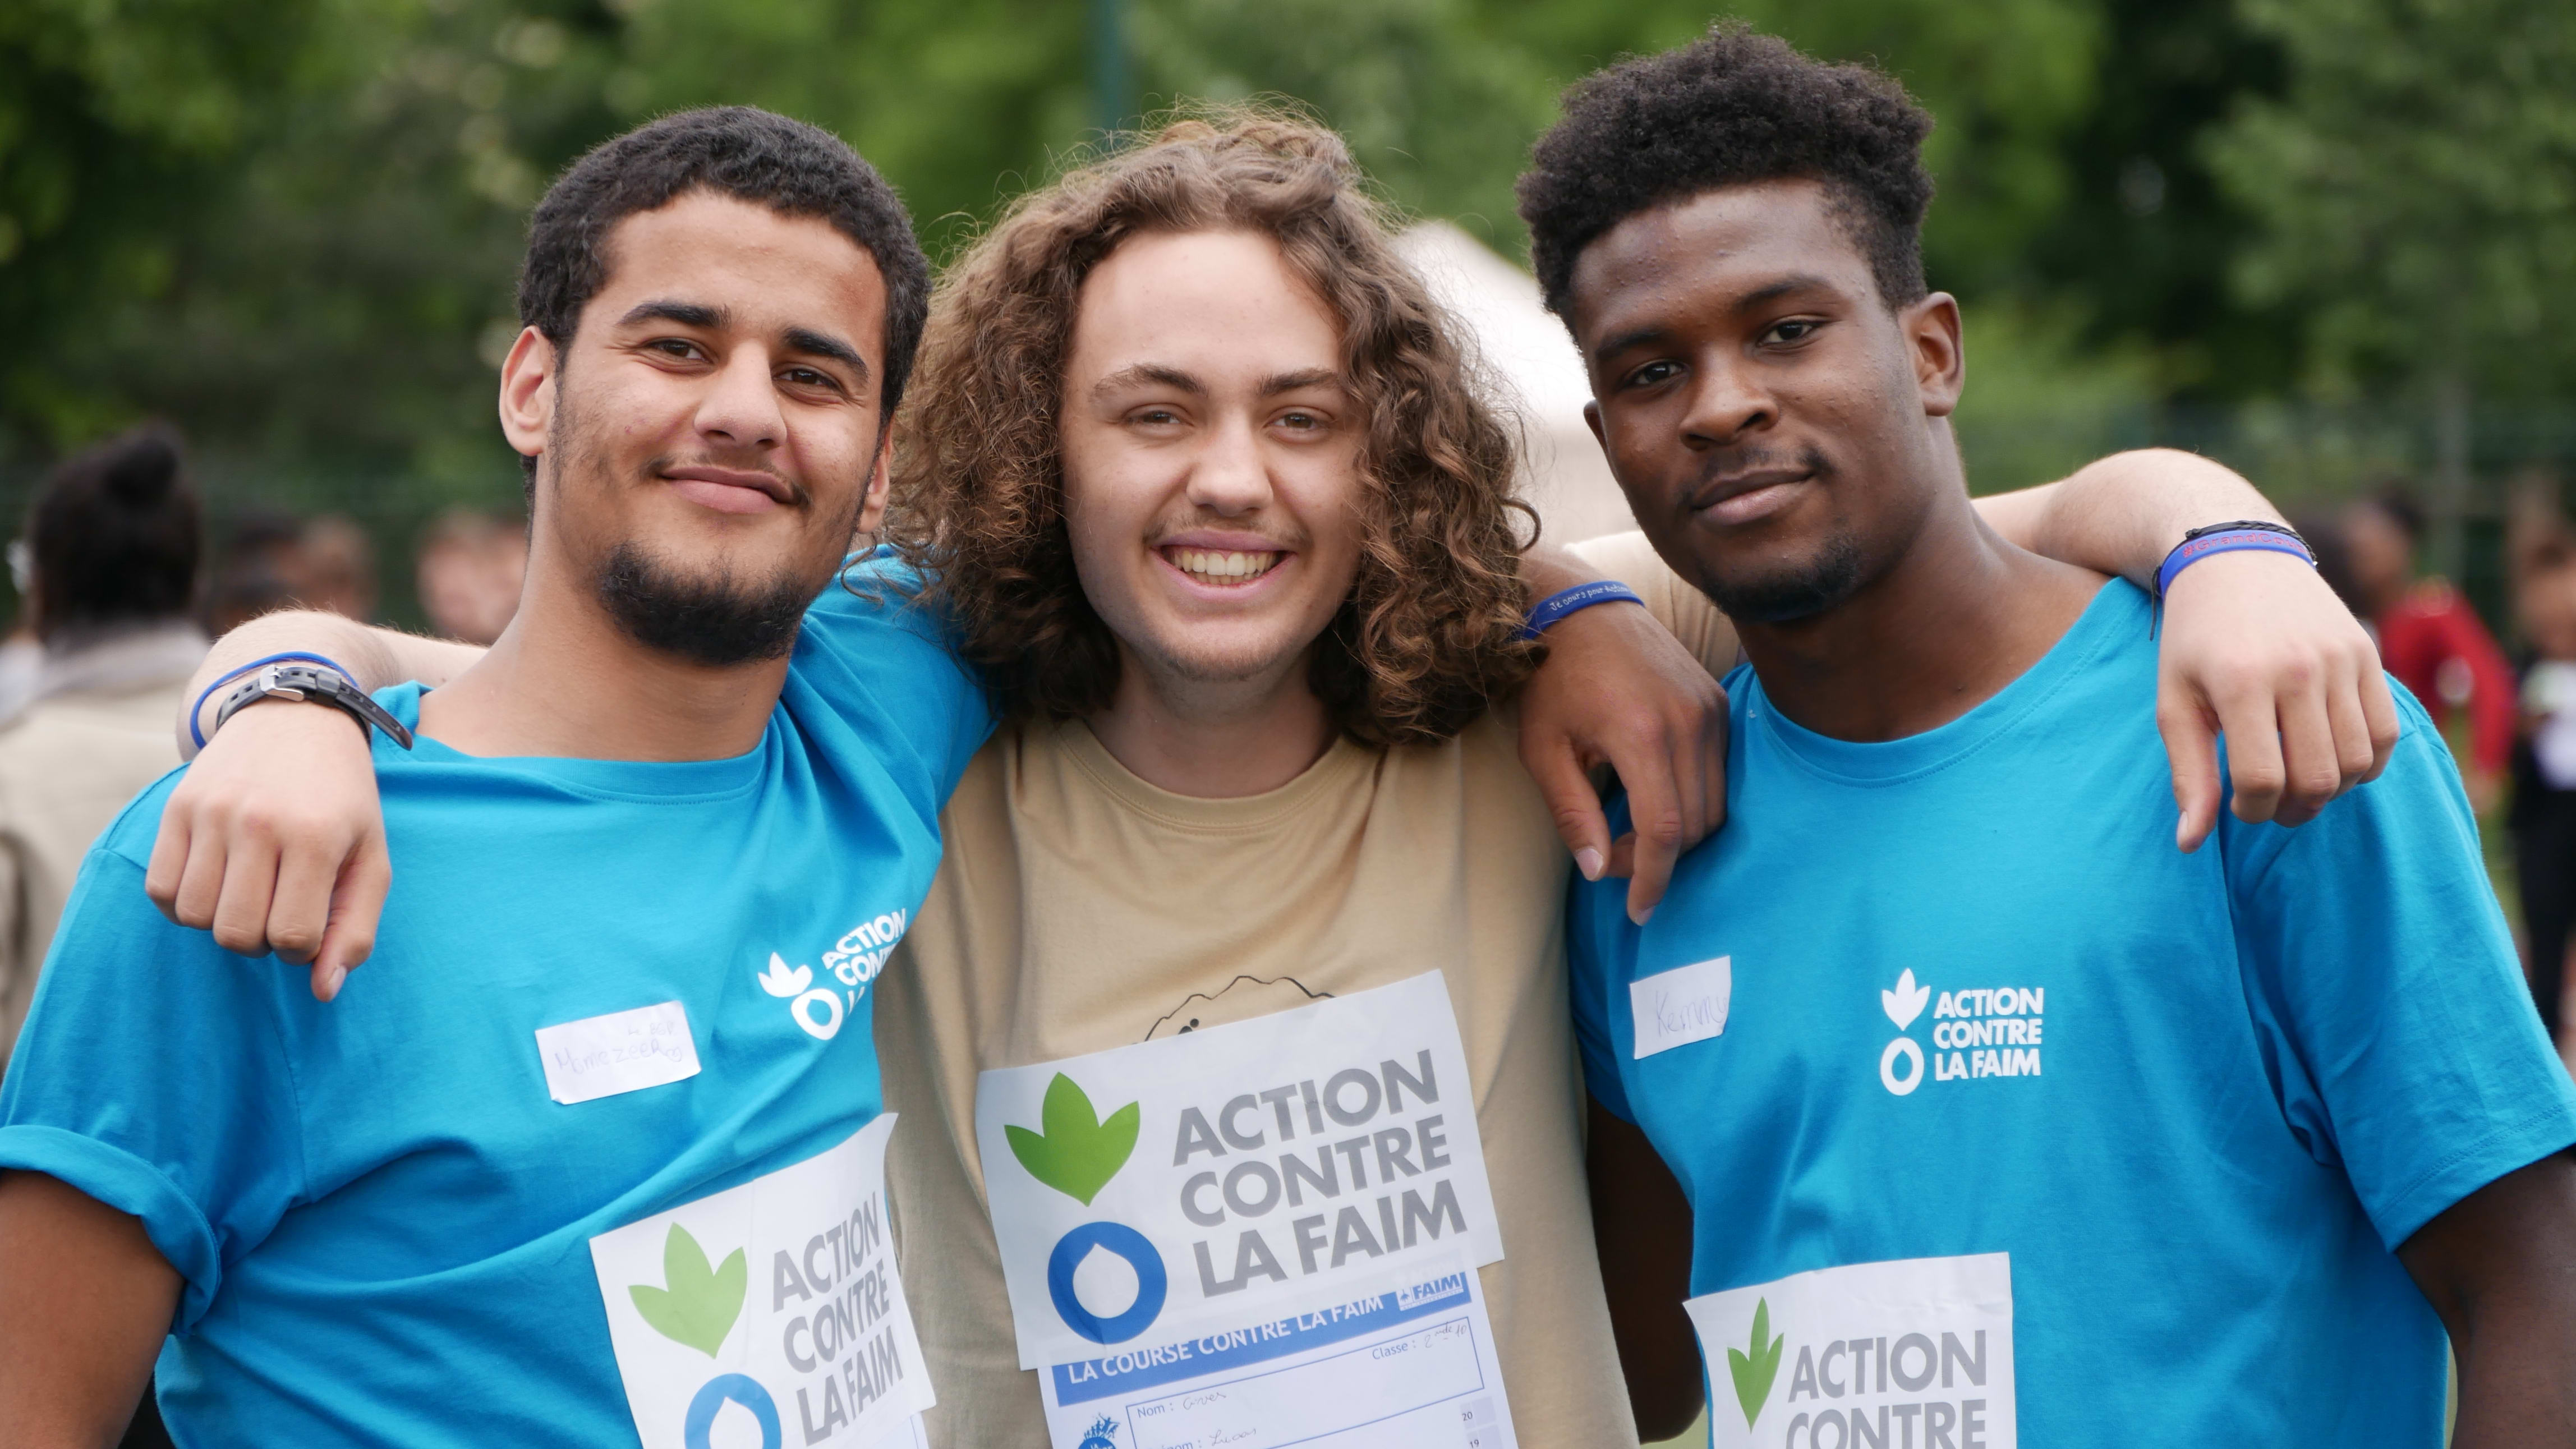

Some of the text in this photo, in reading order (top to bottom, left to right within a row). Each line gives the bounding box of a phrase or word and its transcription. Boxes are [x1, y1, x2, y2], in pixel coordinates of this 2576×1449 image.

[1549, 601, 1563, 611] Je
[1563, 591, 1586, 606] cours
[1587, 587, 1603, 599] pour
[821, 908, 907, 970] ACTION
[835, 942, 899, 986] CONT
[1933, 987, 2045, 1019] ACTION
[1933, 1019, 2043, 1050] CONTRE
[1935, 1048, 2041, 1081] LA FAIM
[1173, 1048, 1440, 1167] ACTION
[1180, 1113, 1452, 1227] CONTRE
[773, 1190, 881, 1313] ACTION
[1193, 1179, 1468, 1298] LA FAIM
[1412, 1273, 1460, 1300] FAIM
[783, 1257, 890, 1374] CONTRE
[1068, 1361, 1098, 1384] LA
[1102, 1344, 1193, 1377] COURSE
[1197, 1319, 1291, 1355] CONTRE
[1296, 1310, 1327, 1332] LA
[1330, 1294, 1384, 1324] FAIM
[1372, 1342, 1409, 1360] Classe
[1787, 1330, 1986, 1403] ACTION
[796, 1324, 904, 1447] LA FAIM
[1137, 1404, 1166, 1419] Nom
[1462, 1411, 1473, 1422] 20
[1786, 1399, 1986, 1449] CONTRE
[1470, 1439, 1479, 1449] 19
